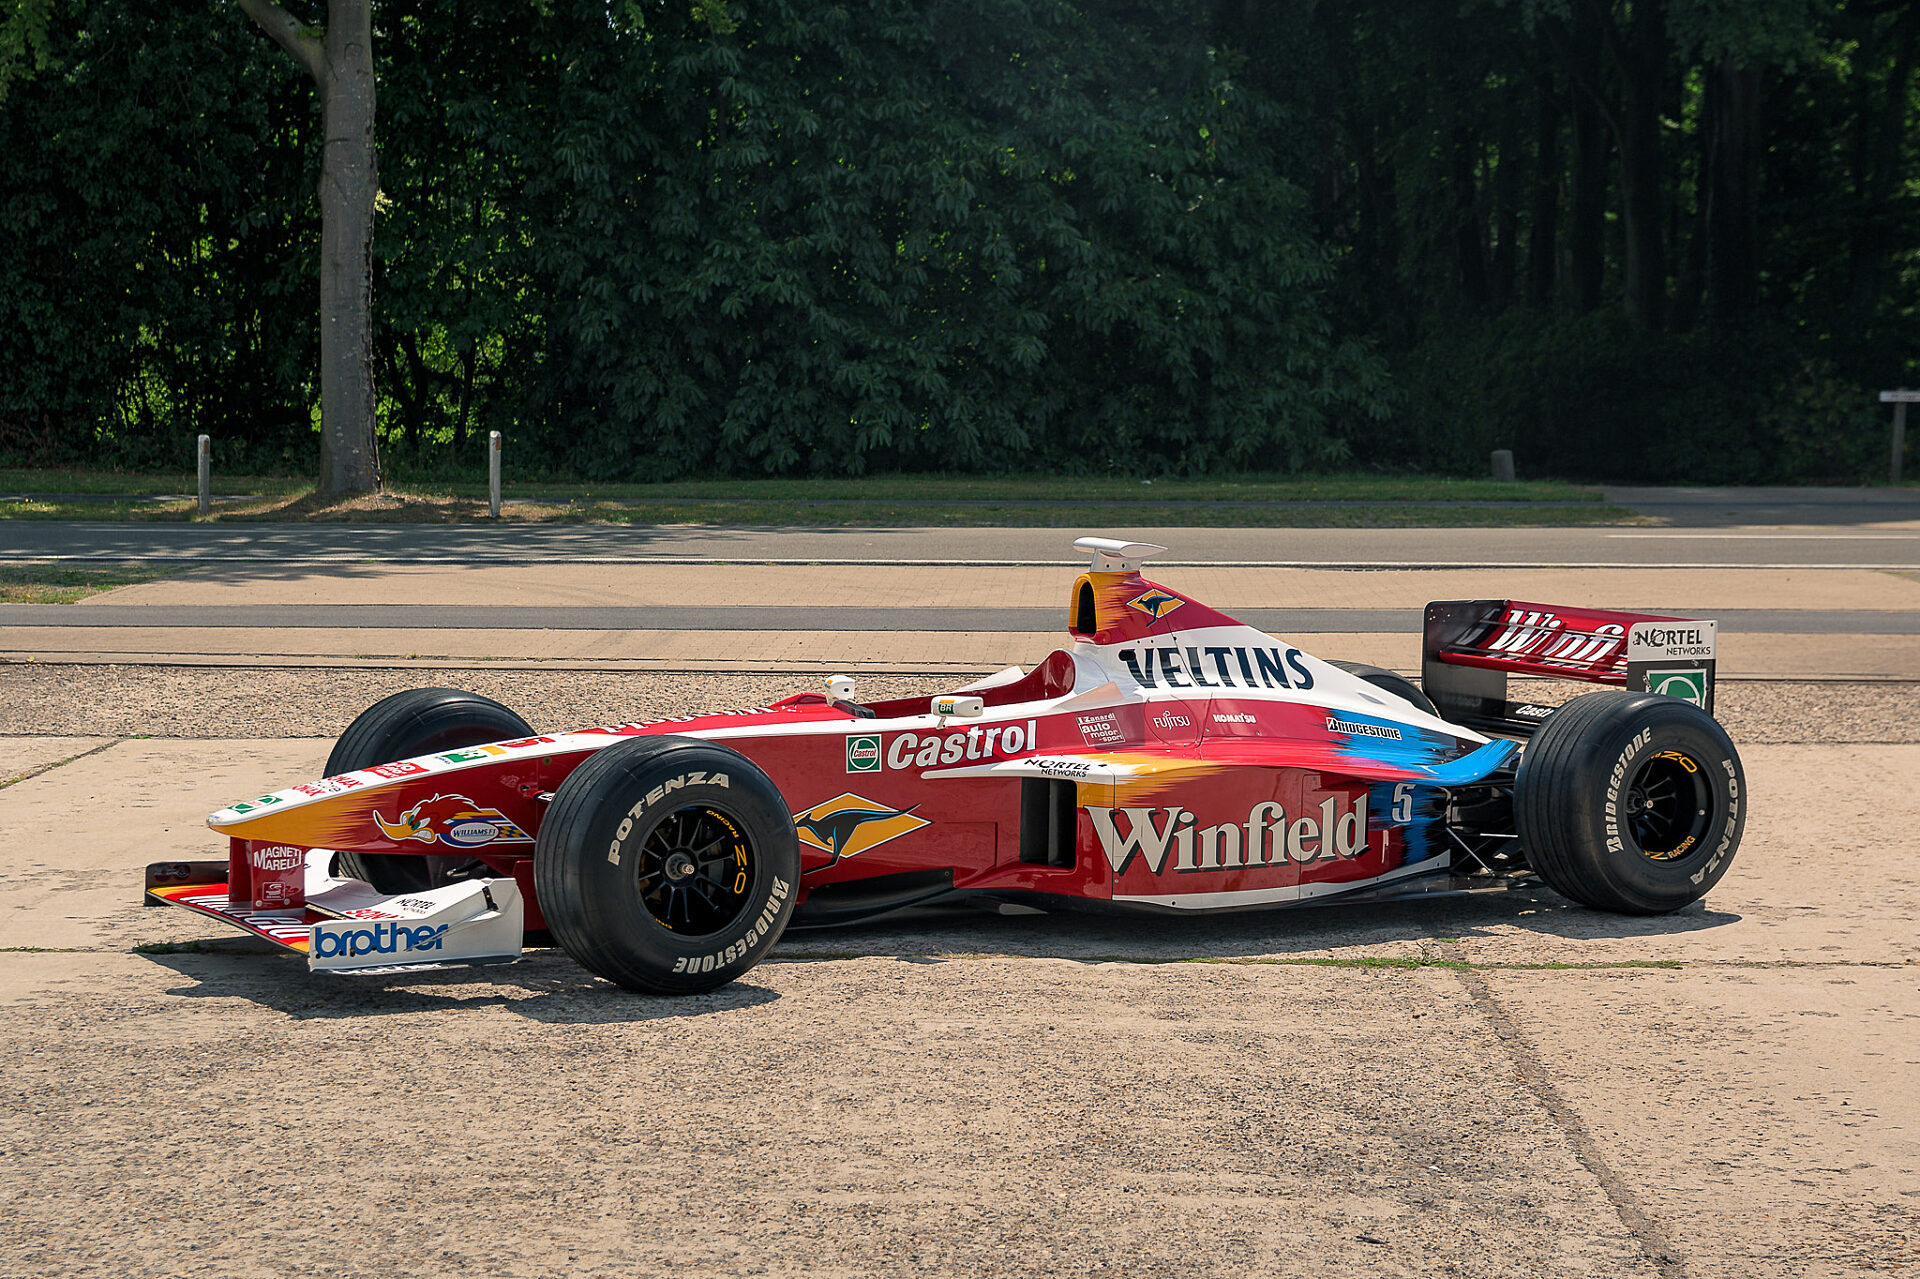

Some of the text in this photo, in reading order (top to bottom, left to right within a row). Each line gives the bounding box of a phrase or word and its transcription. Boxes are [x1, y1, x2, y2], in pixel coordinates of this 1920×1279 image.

[1633, 628, 1703, 647] NORTEL
[1666, 646, 1711, 656] NETWORKS
[1119, 647, 1315, 690] VELTINS
[939, 704, 953, 712] BR
[1213, 713, 1257, 724] KOMATSU
[1081, 722, 1111, 734] auto
[1153, 711, 1191, 730] FUJITSU
[1327, 718, 1402, 740] BRIDGESTONE
[886, 719, 1037, 770] Castrol
[1090, 729, 1118, 739] motor
[853, 749, 877, 758] Castrol
[1023, 758, 1092, 771] NORTEL
[1041, 768, 1088, 778] NETWORKS
[1605, 726, 1652, 854] BRIDGESTONE
[1391, 783, 1416, 822] 5
[608, 771, 730, 866] POTENZA
[705, 809, 740, 839] RACING
[1690, 759, 1739, 885] POTENZA
[453, 828, 488, 838] WILLIAMS
[1084, 792, 1371, 875] Winfield
[1667, 835, 1696, 859] RACING
[672, 875, 790, 974] BRIDGESTONE
[315, 922, 449, 958] brother
